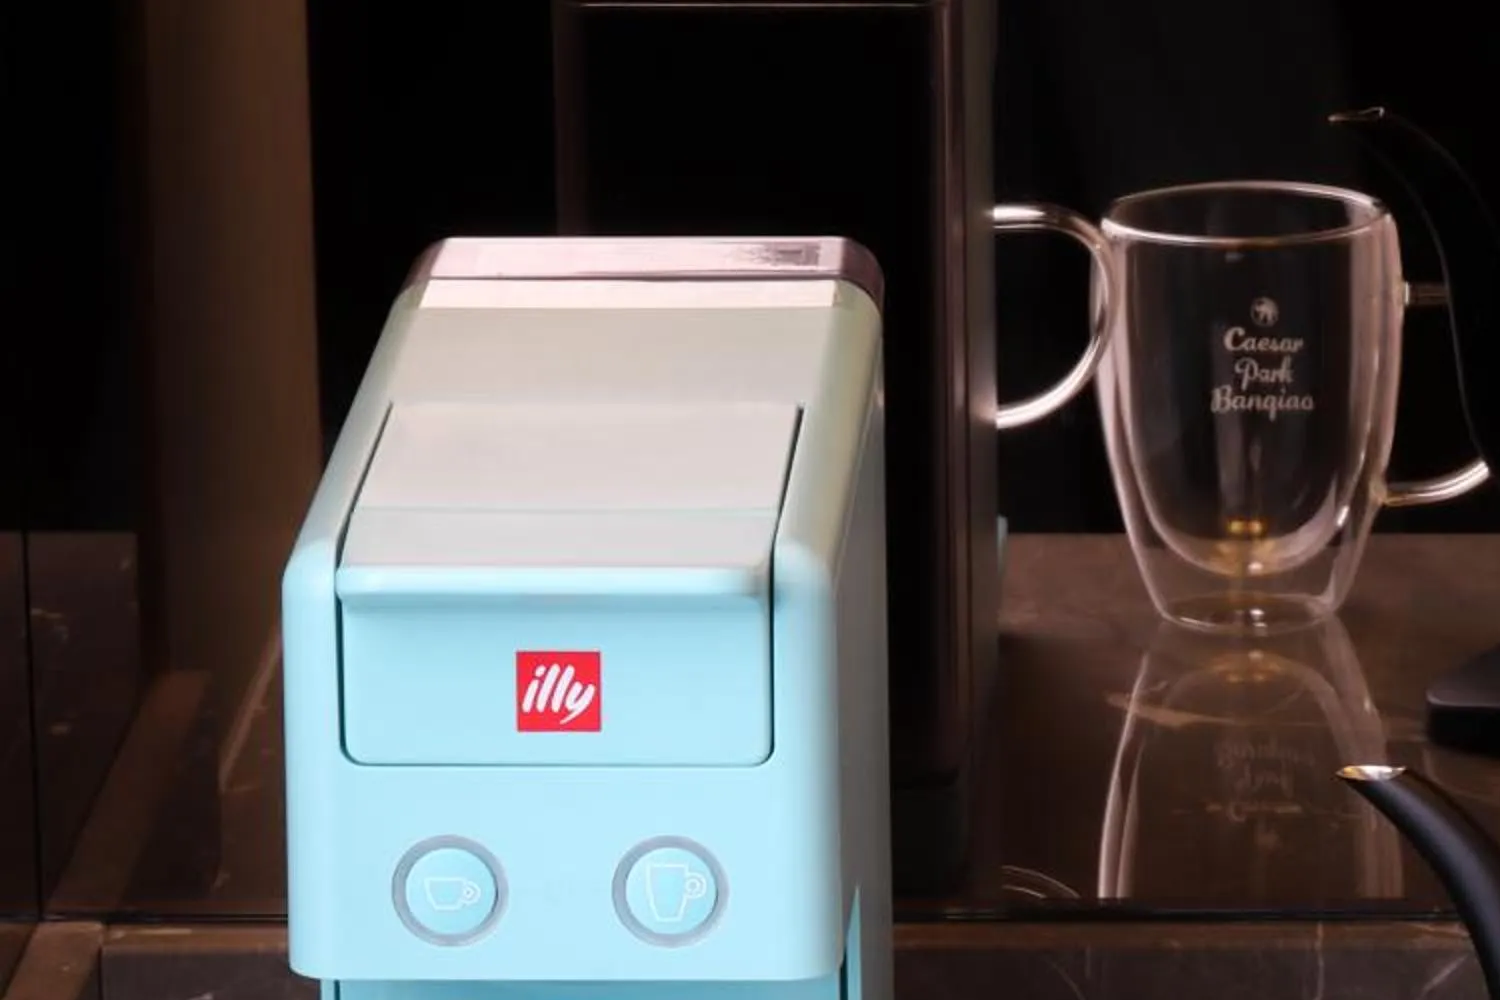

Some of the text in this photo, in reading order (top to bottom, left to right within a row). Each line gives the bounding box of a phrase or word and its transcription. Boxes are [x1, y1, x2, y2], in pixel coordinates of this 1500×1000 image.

[1223, 326, 1304, 352] Caesar
[1234, 355, 1294, 391] Park
[1210, 384, 1315, 422] Banqiao
[521, 663, 596, 725] illy
